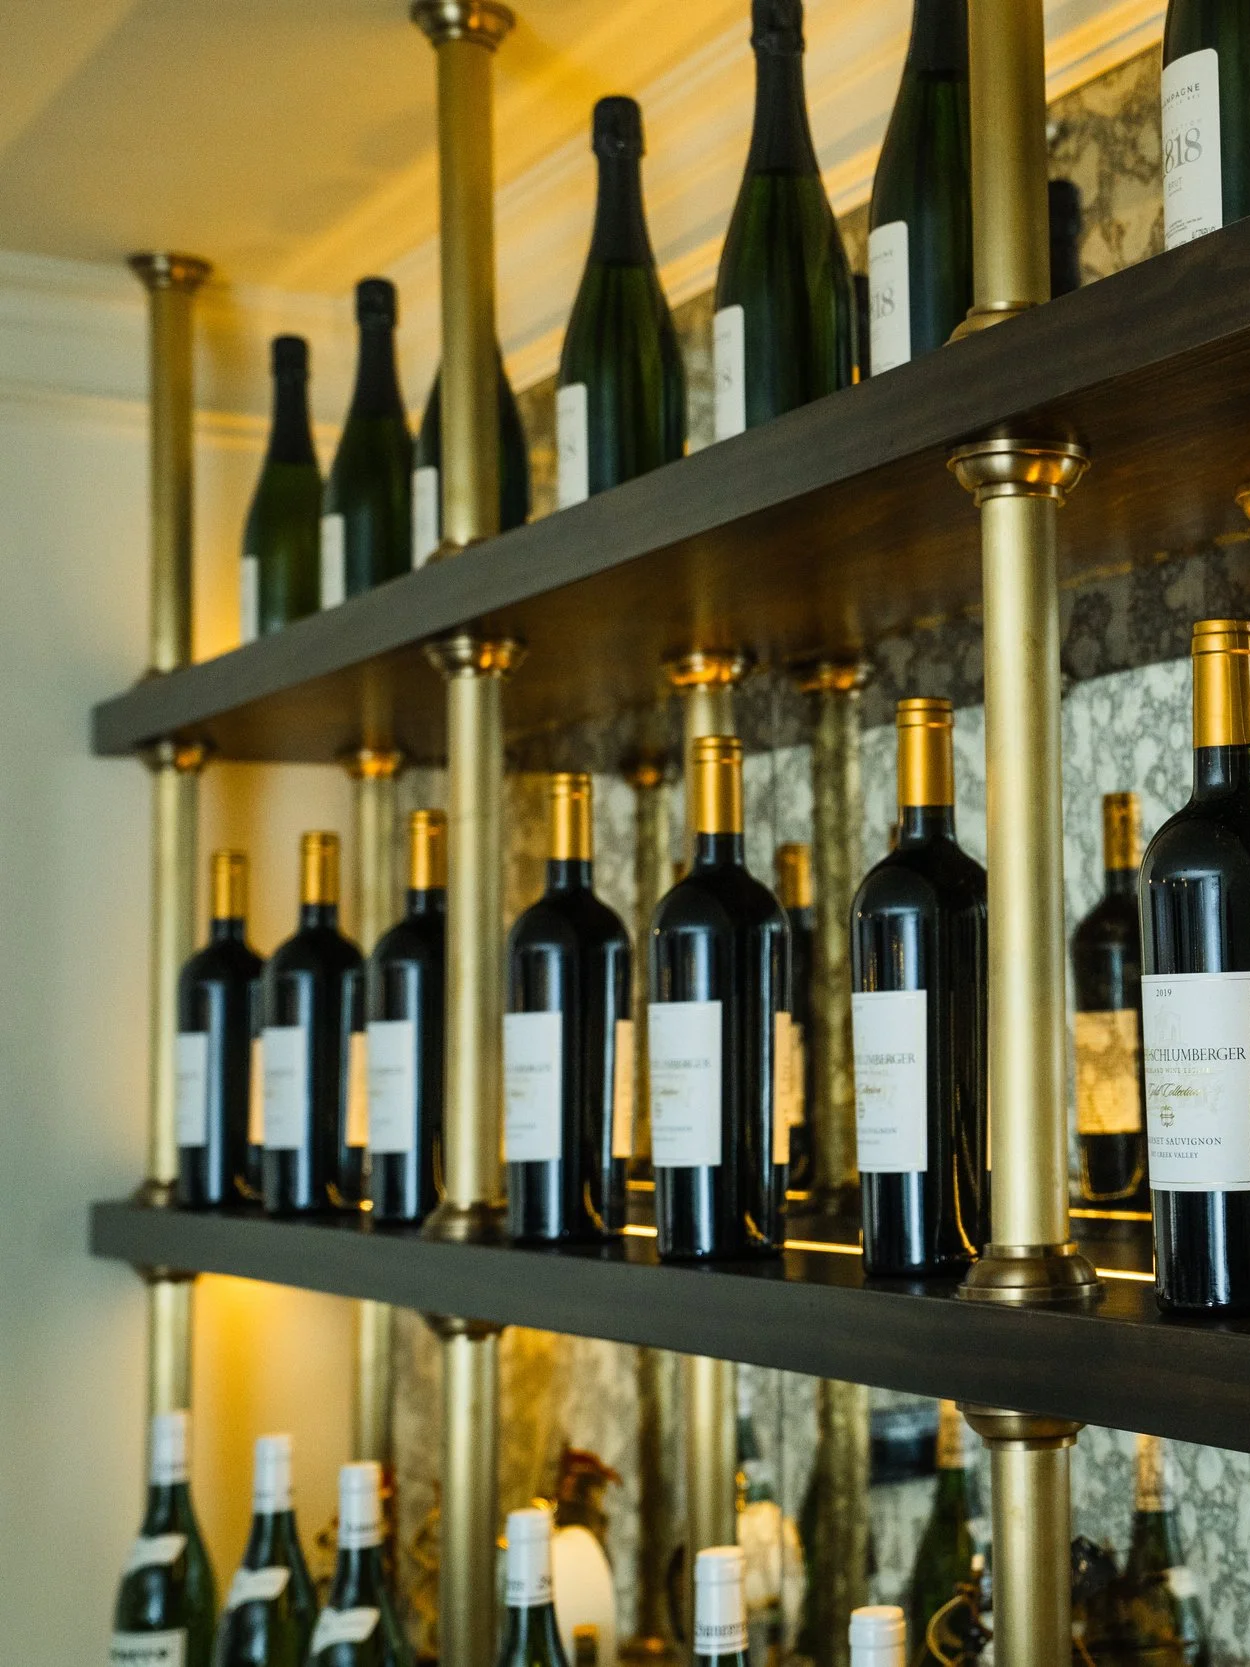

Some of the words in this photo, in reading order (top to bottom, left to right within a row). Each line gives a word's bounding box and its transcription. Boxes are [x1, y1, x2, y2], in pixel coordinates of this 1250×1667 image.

[1164, 127, 1203, 178] 818
[1156, 988, 1172, 998] 2019
[1165, 1137, 1222, 1146] SAUVIGNON
[1173, 1151, 1199, 1159] VALLEY
